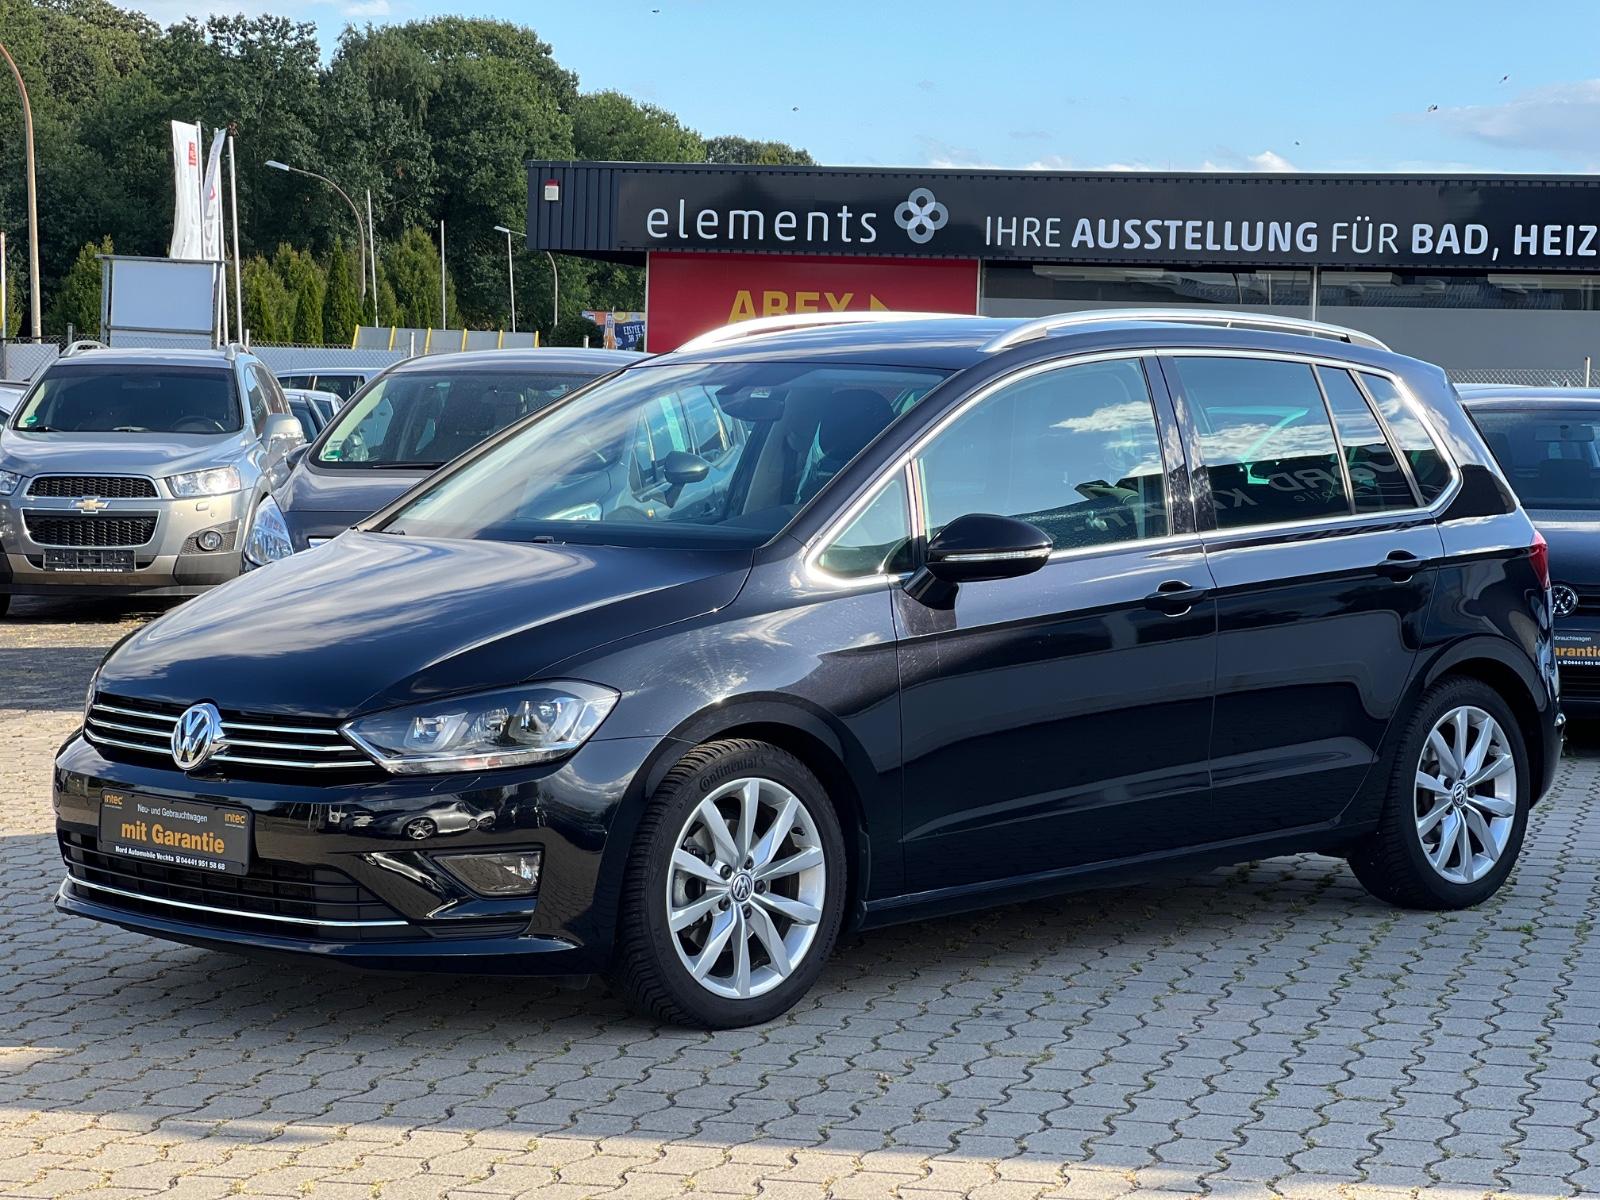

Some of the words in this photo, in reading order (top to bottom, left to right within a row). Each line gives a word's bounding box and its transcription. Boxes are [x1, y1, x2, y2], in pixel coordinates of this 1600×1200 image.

[646, 199, 877, 244] elements
[985, 216, 1061, 248] IHRE
[1071, 218, 1318, 253] AUSSTELLUNG
[1331, 216, 1398, 253] FÜR
[1411, 223, 1500, 262] BAD,
[137, 803, 150, 814] Neu-
[150, 807, 161, 816] und
[161, 808, 208, 823] Gebrauchtwagen
[115, 845, 128, 854] Nord
[128, 848, 156, 859] Automobile
[121, 821, 147, 841] mit
[151, 824, 225, 854] Garantie
